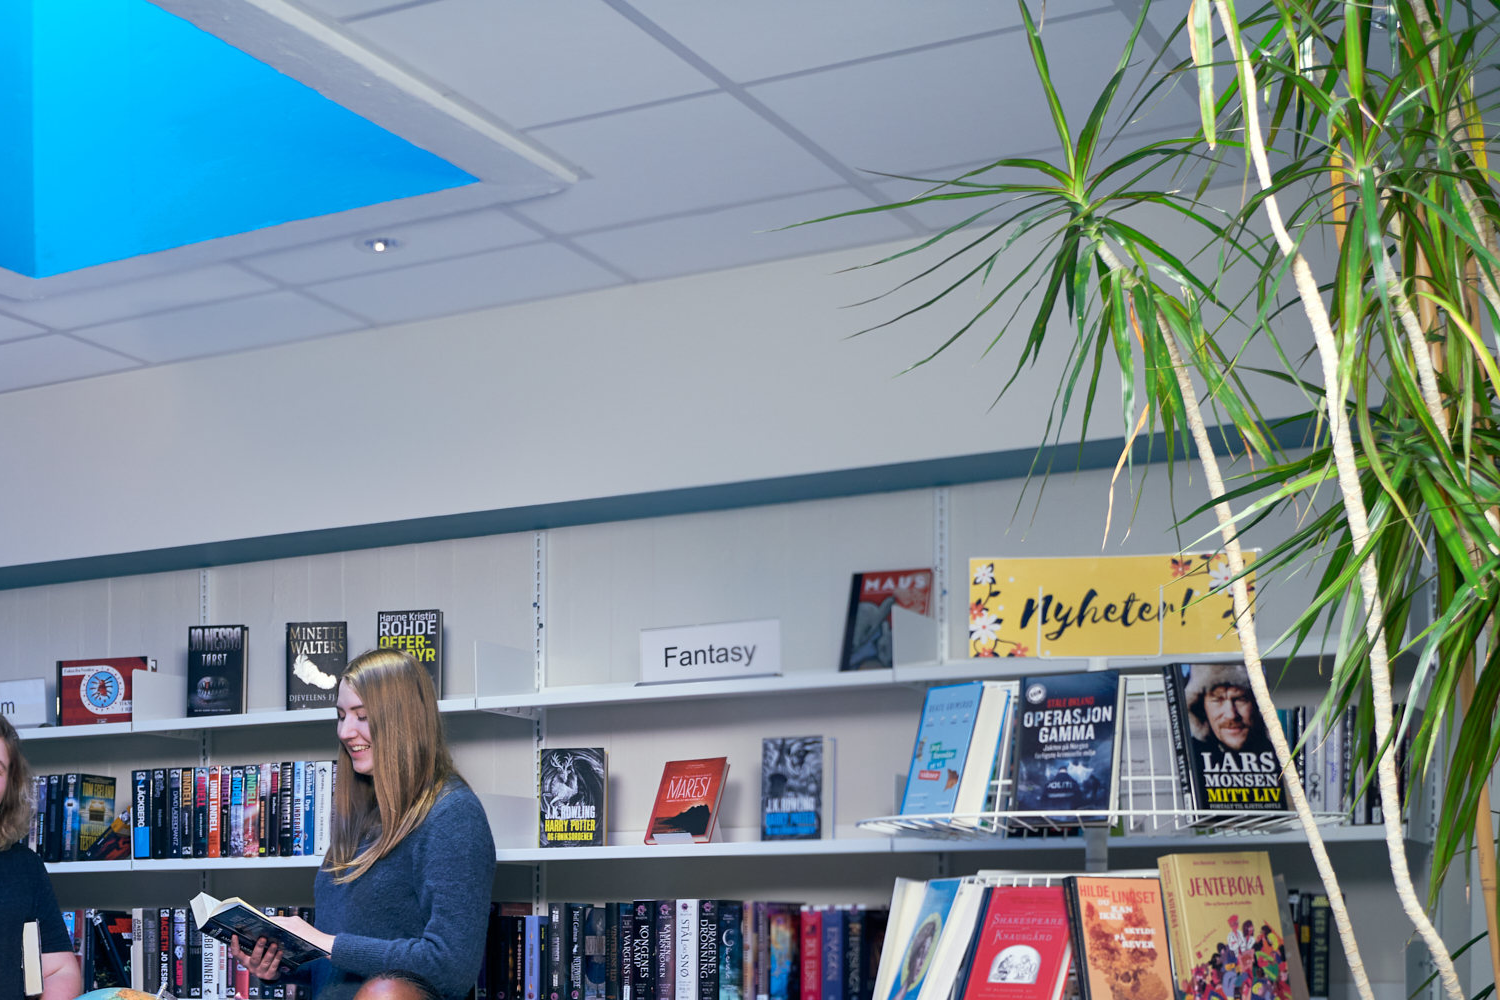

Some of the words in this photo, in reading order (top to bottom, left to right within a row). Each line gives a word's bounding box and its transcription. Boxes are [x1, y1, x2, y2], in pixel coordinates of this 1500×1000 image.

[380, 613, 407, 622] Hanne
[409, 611, 437, 621] Kristin
[1019, 588, 1194, 641] Nyheter!
[290, 626, 344, 640] MINETTE
[380, 620, 437, 636] ROHDE
[290, 640, 344, 655] WALTERS
[663, 643, 757, 669] Fantasy
[202, 653, 228, 667] TØRST
[289, 694, 326, 702] DJEVELENS
[1023, 705, 1112, 728] OPERASJON
[1038, 723, 1095, 744] GAMMA
[1170, 706, 1182, 750] MONSEN
[1201, 751, 1275, 773] LARS
[82, 782, 93, 796] TOM
[667, 777, 711, 799] MARESI
[1203, 773, 1279, 788] MONSEN
[197, 776, 206, 808] INDELL
[1206, 788, 1250, 803] MITT
[1253, 787, 1281, 802] LIV
[137, 785, 146, 827] LÄCKBERG
[281, 791, 291, 831] LINDELL
[561, 805, 595, 819] ROWLING
[545, 820, 568, 832] HARRY
[570, 819, 595, 831] POTTER
[1079, 885, 1110, 898] HILDE
[1187, 875, 1265, 897] JENTEBOKA
[1099, 912, 1124, 921] IKKE
[1110, 905, 1133, 914] KAN
[989, 914, 1064, 930] SHAKESPEARE
[1315, 909, 1324, 933] MED
[681, 919, 692, 945] STÅL
[991, 930, 1053, 946] KNAUSGÅRD
[640, 925, 649, 978] KONGENES
[700, 919, 709, 979] DRONNING
[707, 923, 717, 974] DRAGENES
[1122, 941, 1156, 949] REVER
[161, 952, 168, 962] JO
[680, 954, 689, 978] SNØ
[204, 952, 213, 984] SØNNEN
[1314, 957, 1325, 992] LEKEN
